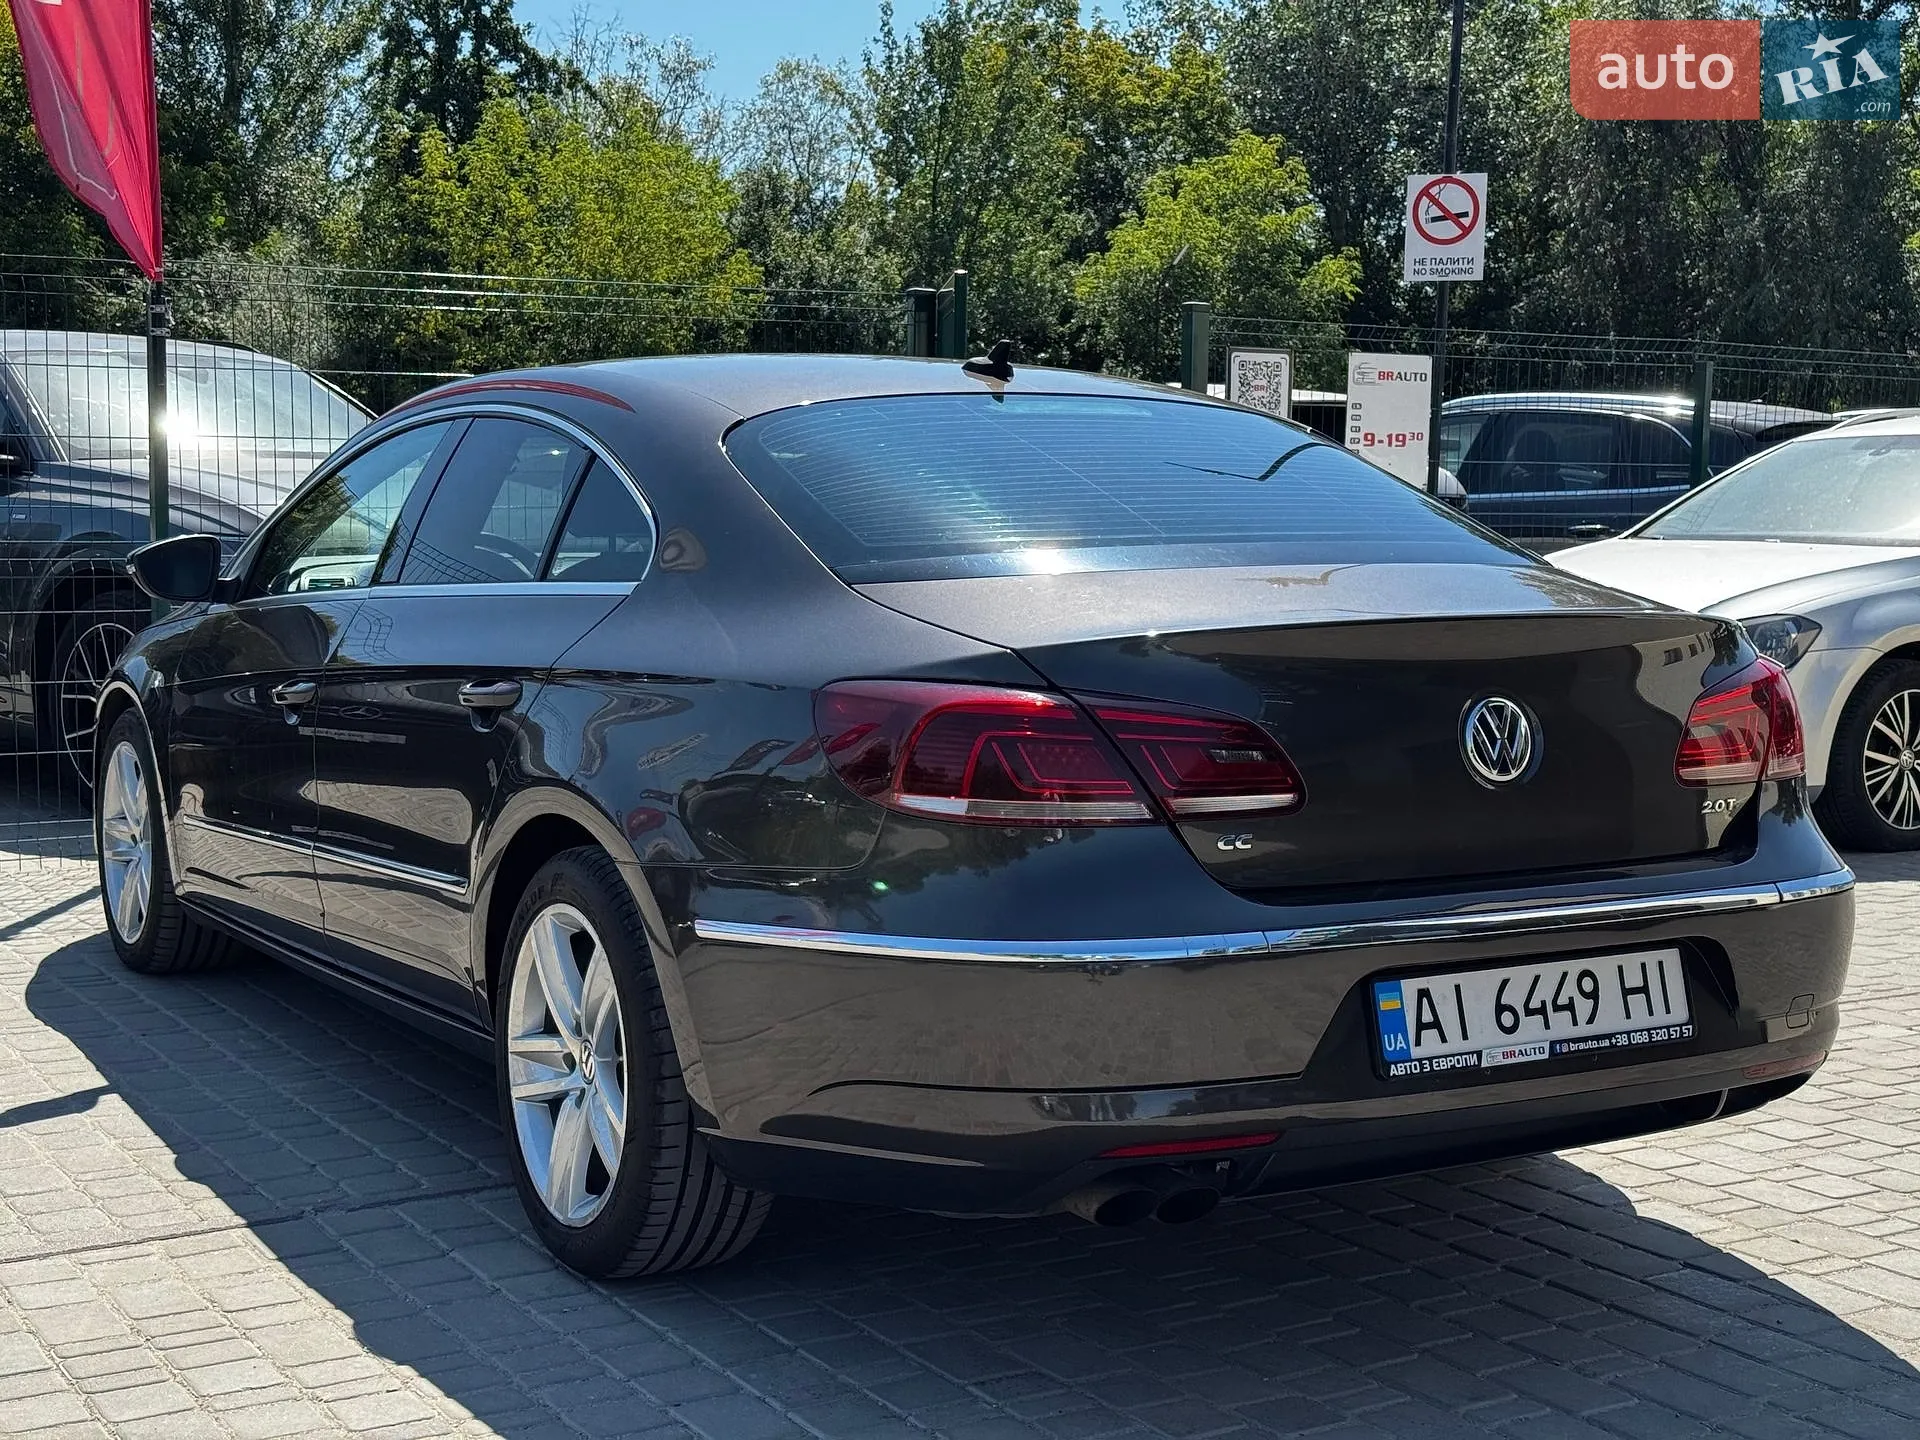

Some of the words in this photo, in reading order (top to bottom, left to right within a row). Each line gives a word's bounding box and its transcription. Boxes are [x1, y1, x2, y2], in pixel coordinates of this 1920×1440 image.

[1413, 257, 1428, 266] НЕ
[1429, 256, 1475, 266] ПАЛИТИ
[1412, 267, 1428, 276] NO
[1429, 267, 1475, 276] SMOKING
[1377, 370, 1428, 383] BRAUTO
[1217, 834, 1253, 851] CC
[1414, 983, 1470, 1048] AI
[1494, 969, 1601, 1036] 6449
[1616, 960, 1672, 1020] HI
[1384, 1032, 1408, 1052] UA
[1611, 1034, 1629, 1046] +38
[1630, 1030, 1649, 1044] 068
[1651, 1028, 1668, 1041] 320
[1669, 1026, 1681, 1039] 57
[1682, 1025, 1693, 1038] 57
[1501, 1046, 1546, 1060] BRAUTO
[1389, 1062, 1421, 1077] АВТО
[1432, 1053, 1479, 1071] ЄВРОПИ
